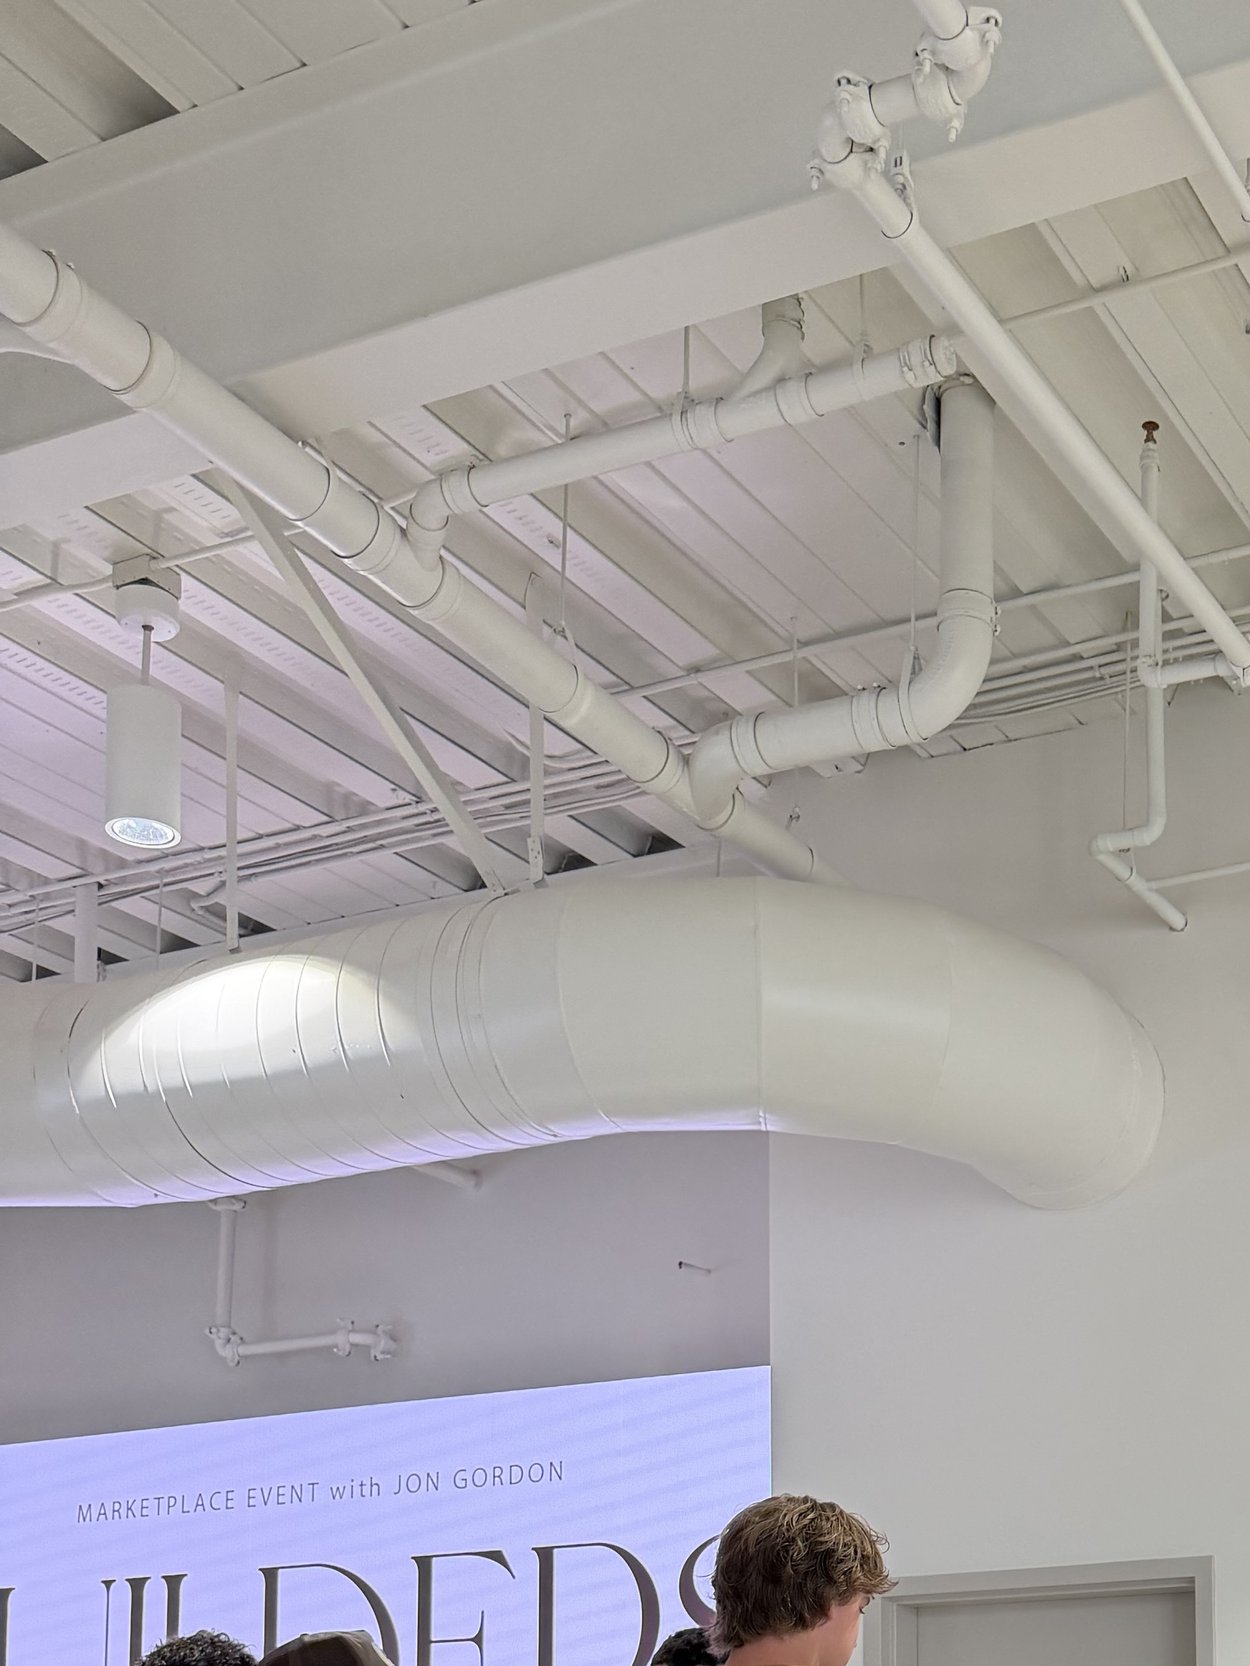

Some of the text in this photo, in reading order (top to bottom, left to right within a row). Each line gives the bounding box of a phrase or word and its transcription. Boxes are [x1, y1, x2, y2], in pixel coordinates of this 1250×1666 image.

[76, 1460, 566, 1525] MARKETPLACE EVENT with JON GORDON
